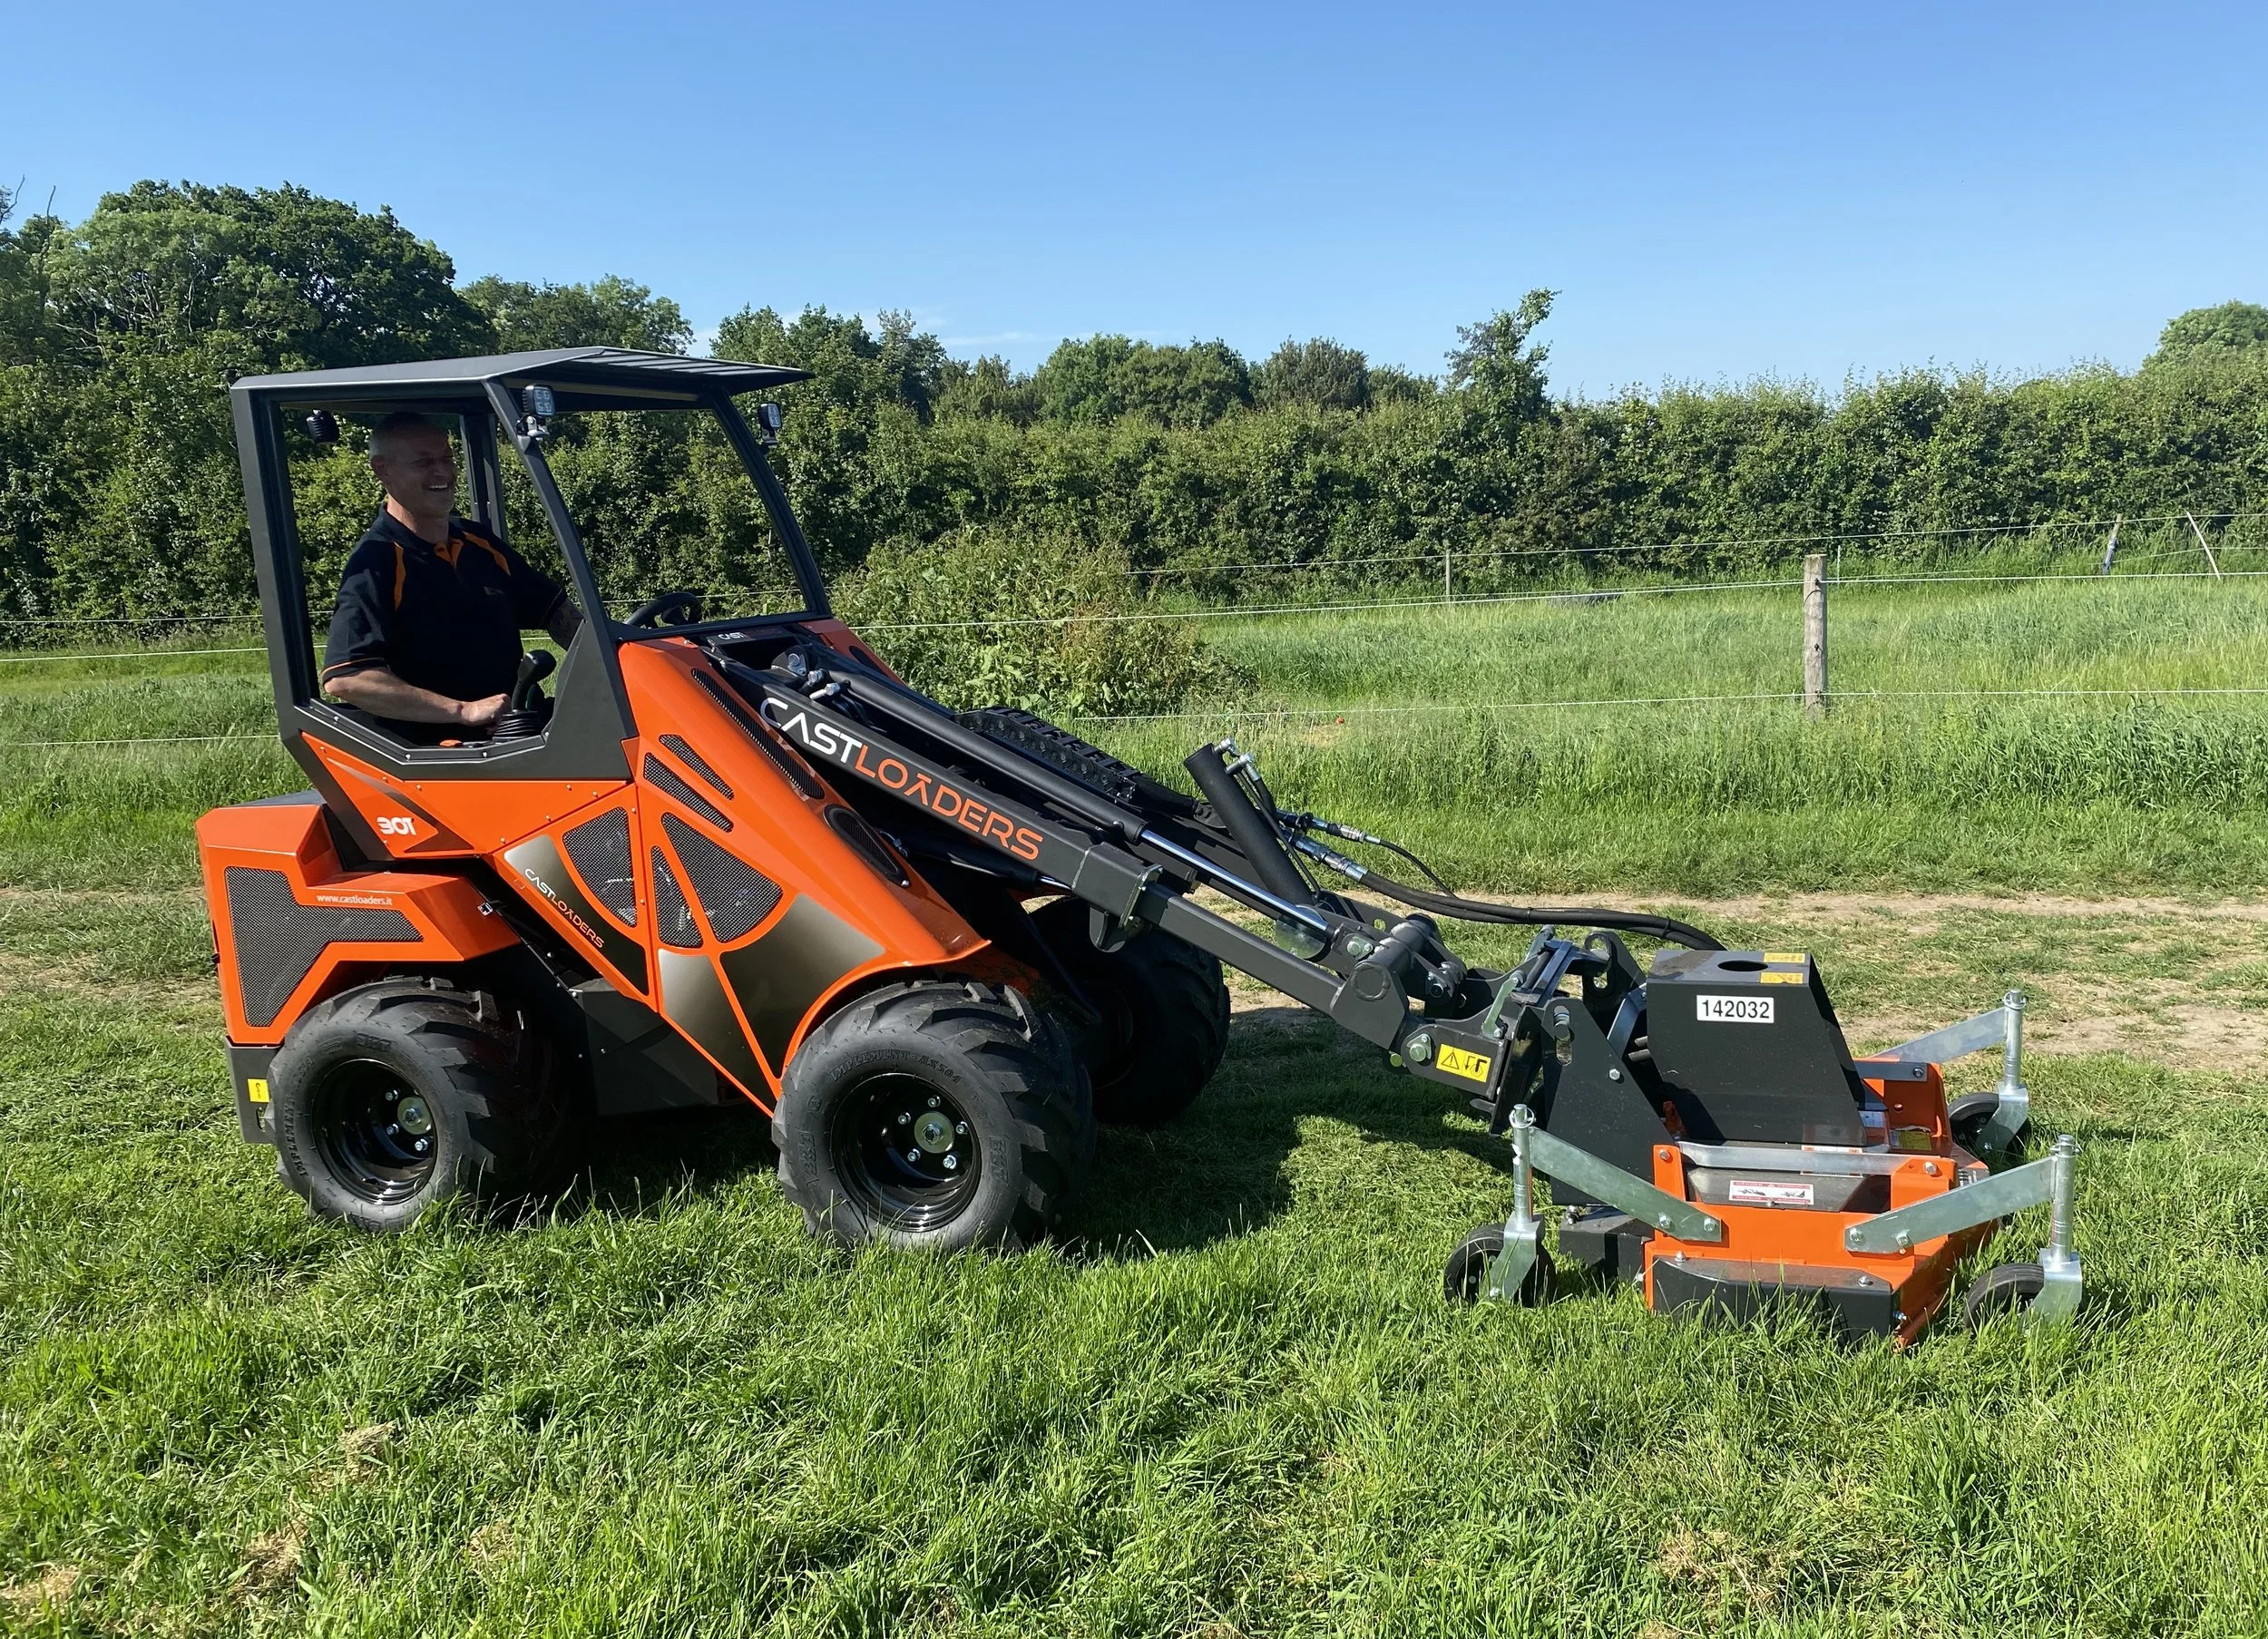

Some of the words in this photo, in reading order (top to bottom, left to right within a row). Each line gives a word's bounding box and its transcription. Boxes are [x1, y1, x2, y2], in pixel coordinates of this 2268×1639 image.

[376, 816, 417, 836] 30T
[316, 894, 393, 906] www.castloaders.it
[1702, 1000, 1770, 1019] 142032
